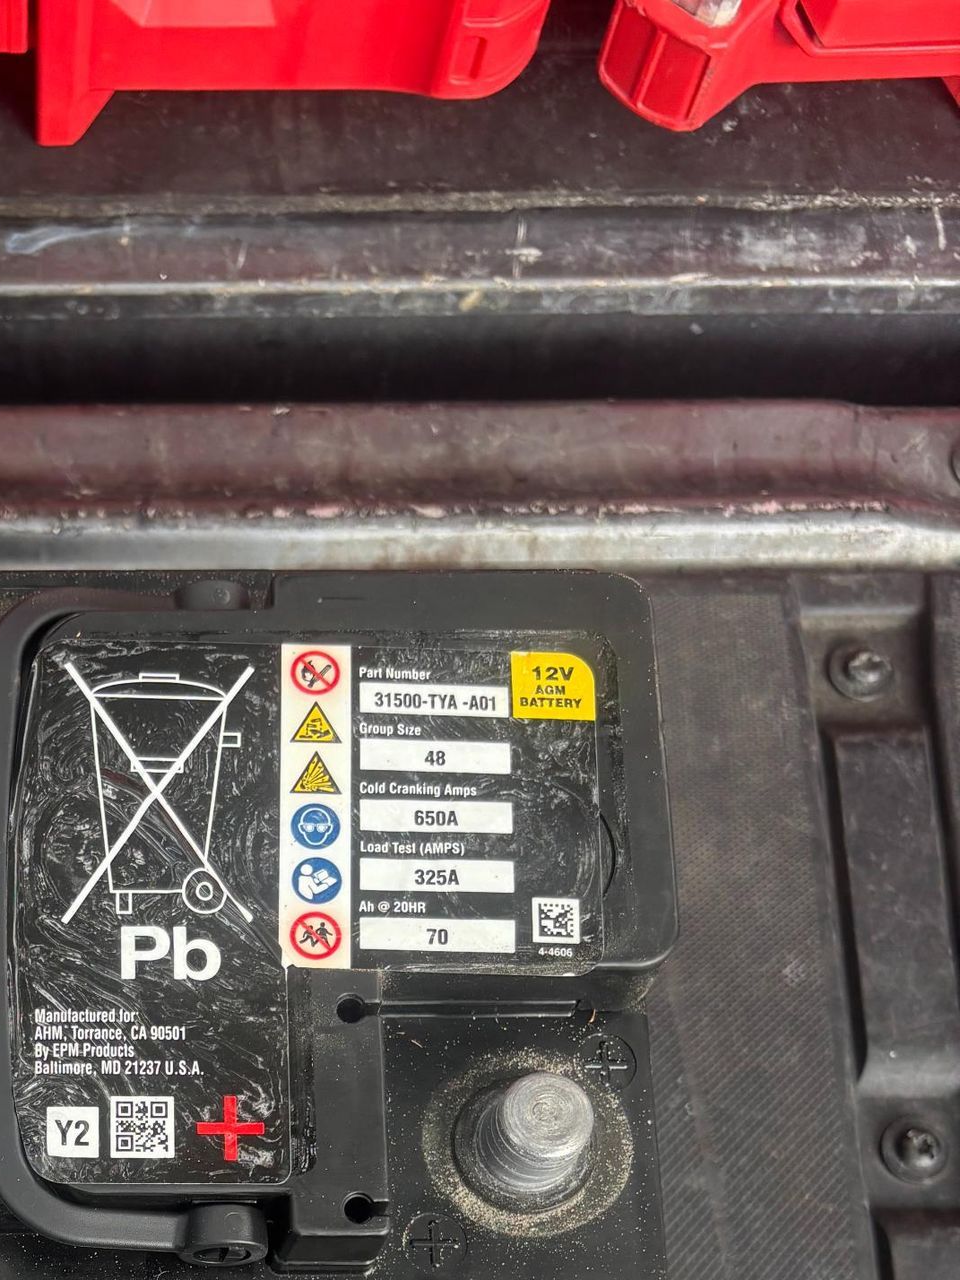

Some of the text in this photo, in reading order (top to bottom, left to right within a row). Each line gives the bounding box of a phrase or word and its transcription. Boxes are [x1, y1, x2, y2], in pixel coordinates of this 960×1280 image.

[359, 668, 430, 681] Part Number
[532, 666, 574, 681] 12V
[536, 685, 565, 695] AGM
[520, 697, 582, 709] BATTERY
[359, 724, 421, 736] Group Size
[425, 751, 445, 766] 48
[360, 783, 477, 798] Cold Cranking Amps
[414, 810, 458, 827] 650A
[360, 842, 389, 854] Load
[420, 842, 465, 856] (AMPS)
[415, 869, 459, 885] 325A
[359, 901, 374, 913] Ah
[394, 901, 426, 913] 20HR
[427, 929, 448, 944] 70
[121, 926, 221, 980] Pb
[538, 947, 573, 957] 4-4606
[35, 1009, 115, 1023] Manufactured
[35, 1026, 185, 1041] AHM, Torrance, CA 90501
[35, 1044, 134, 1059] By EPM Products
[35, 1061, 204, 1075] Baltimore, MD 21237 U.S.A.
[55, 1120, 89, 1146] Y2
